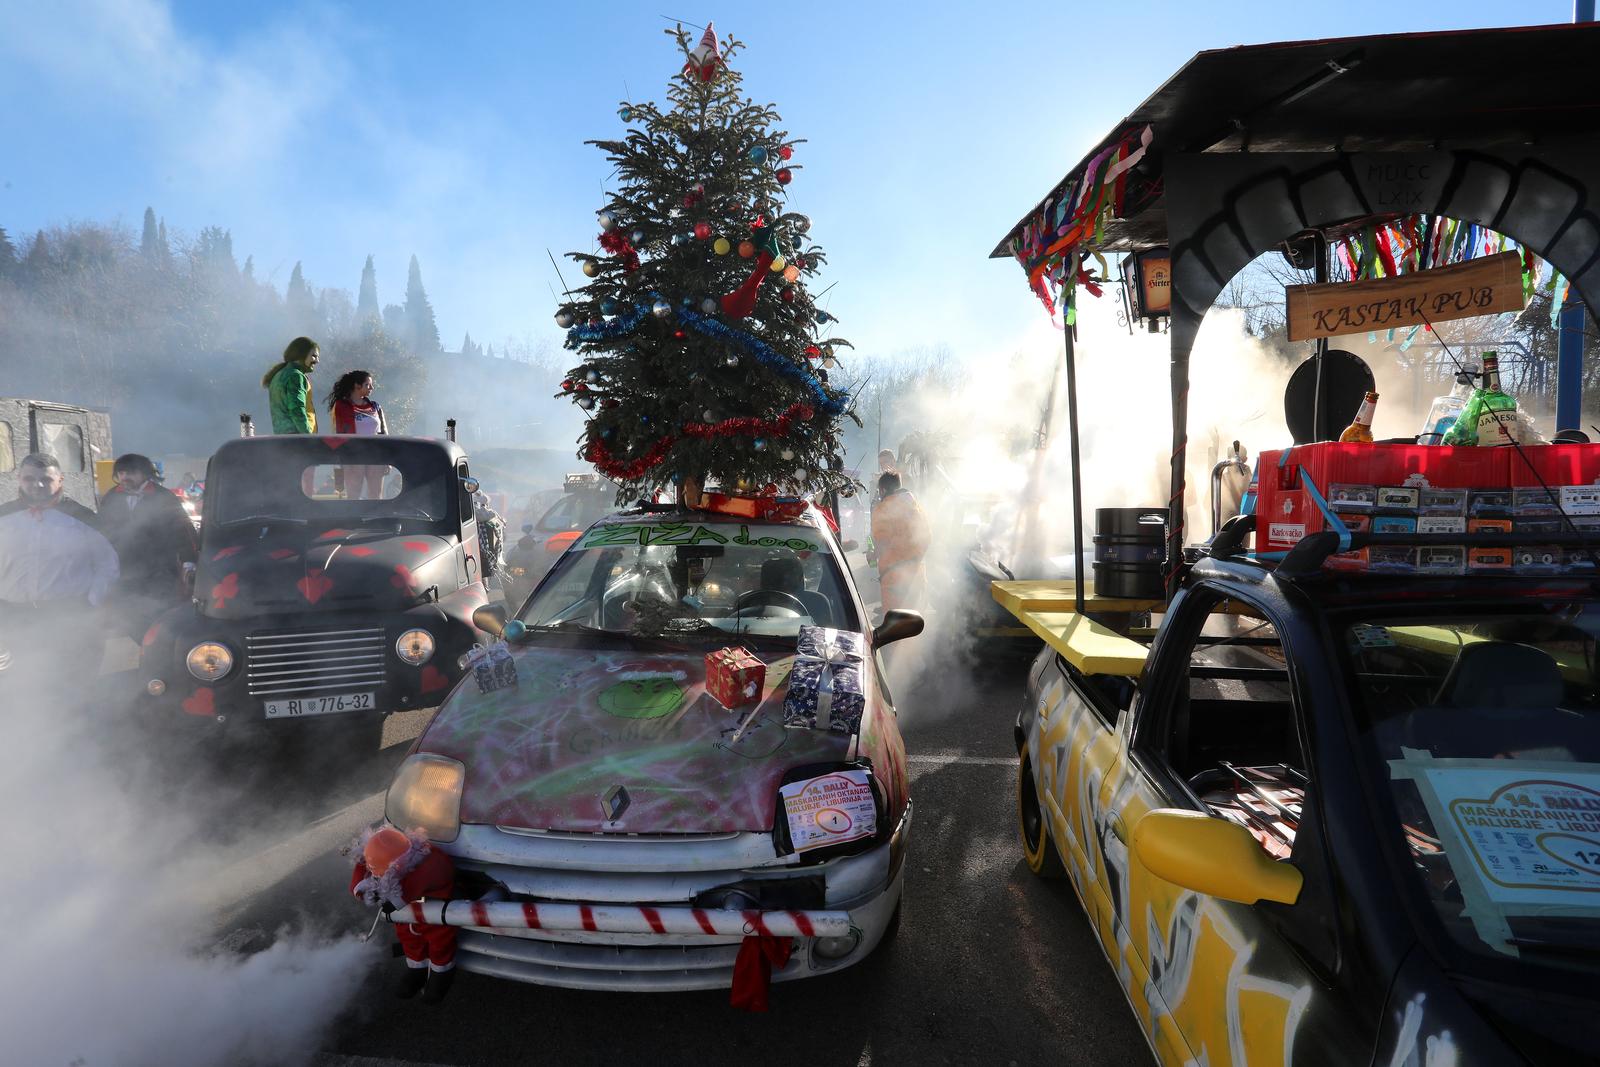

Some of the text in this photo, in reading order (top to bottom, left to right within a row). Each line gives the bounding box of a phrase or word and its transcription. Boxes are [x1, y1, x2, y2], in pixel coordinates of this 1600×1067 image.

[1378, 191, 1423, 205] LXIX
[1313, 286, 1493, 332] KASTAV PUB
[584, 522, 729, 548] ŽIŽA
[288, 700, 303, 715] RI
[320, 694, 369, 712] 776-32
[823, 782, 849, 792] RALLY
[832, 816, 837, 825] 1
[1463, 816, 1545, 830] HALUBJE
[1556, 821, 1600, 832] LIBU
